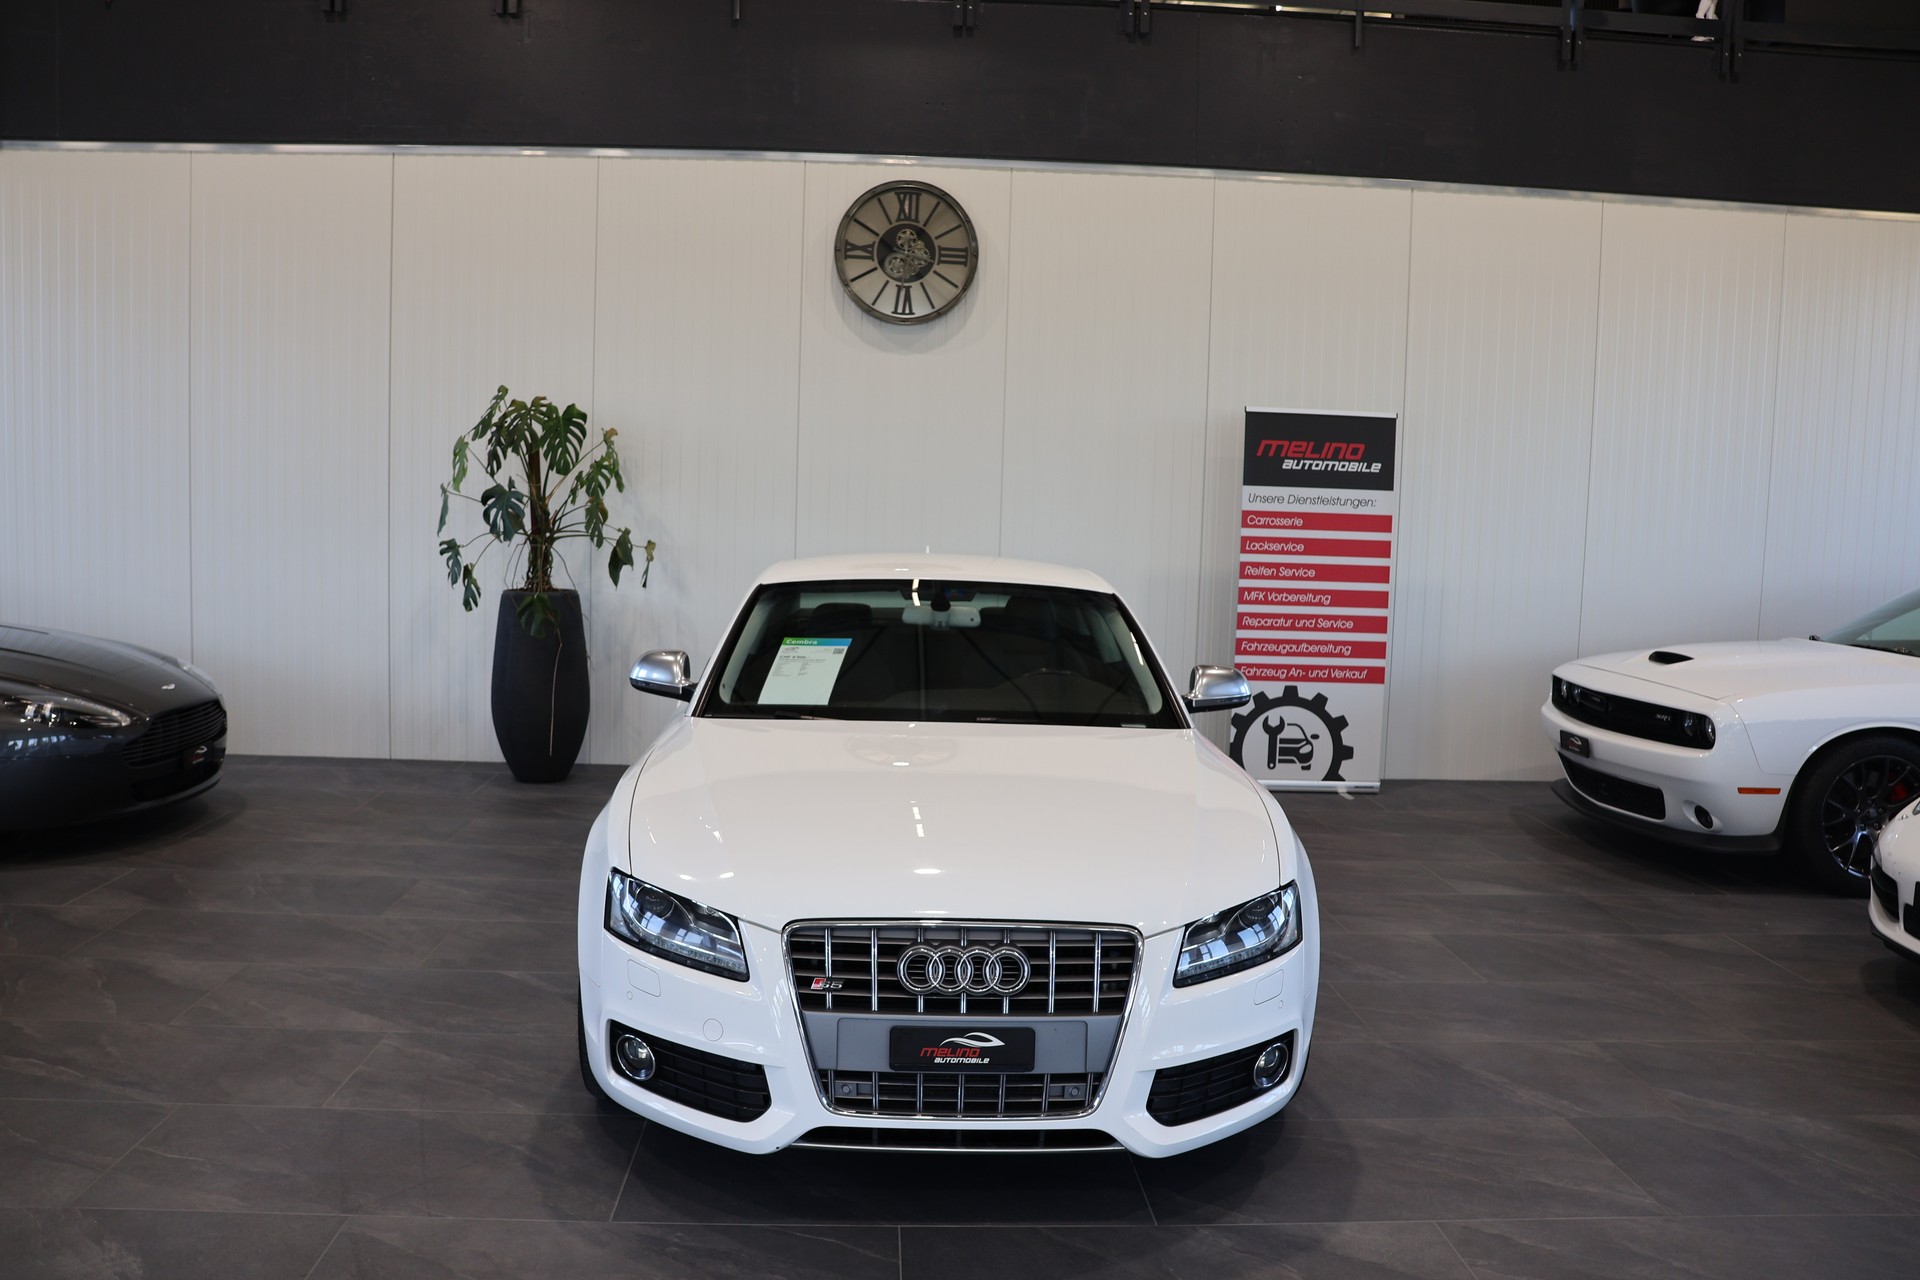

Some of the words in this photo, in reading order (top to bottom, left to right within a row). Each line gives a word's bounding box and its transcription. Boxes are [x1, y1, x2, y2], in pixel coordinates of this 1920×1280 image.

[1248, 493, 1284, 504] Unsere
[1288, 495, 1376, 509] Dienstleistungen:
[1247, 515, 1303, 527] Carrosserie
[1246, 541, 1304, 552] Lackservice
[1245, 566, 1276, 576] Reifen
[1279, 567, 1315, 577] Service
[1243, 591, 1265, 601] MFK
[1267, 592, 1331, 604] Vorbereitung
[1242, 616, 1293, 628] Reparatur
[1296, 618, 1315, 627] und
[1317, 619, 1353, 629] Service
[1241, 642, 1351, 655] Fahrzeugaufbereitung
[1241, 666, 1287, 679] Fahrzeug
[1289, 668, 1305, 677] An-
[1309, 669, 1329, 678] und
[1331, 669, 1367, 679] Verkauf
